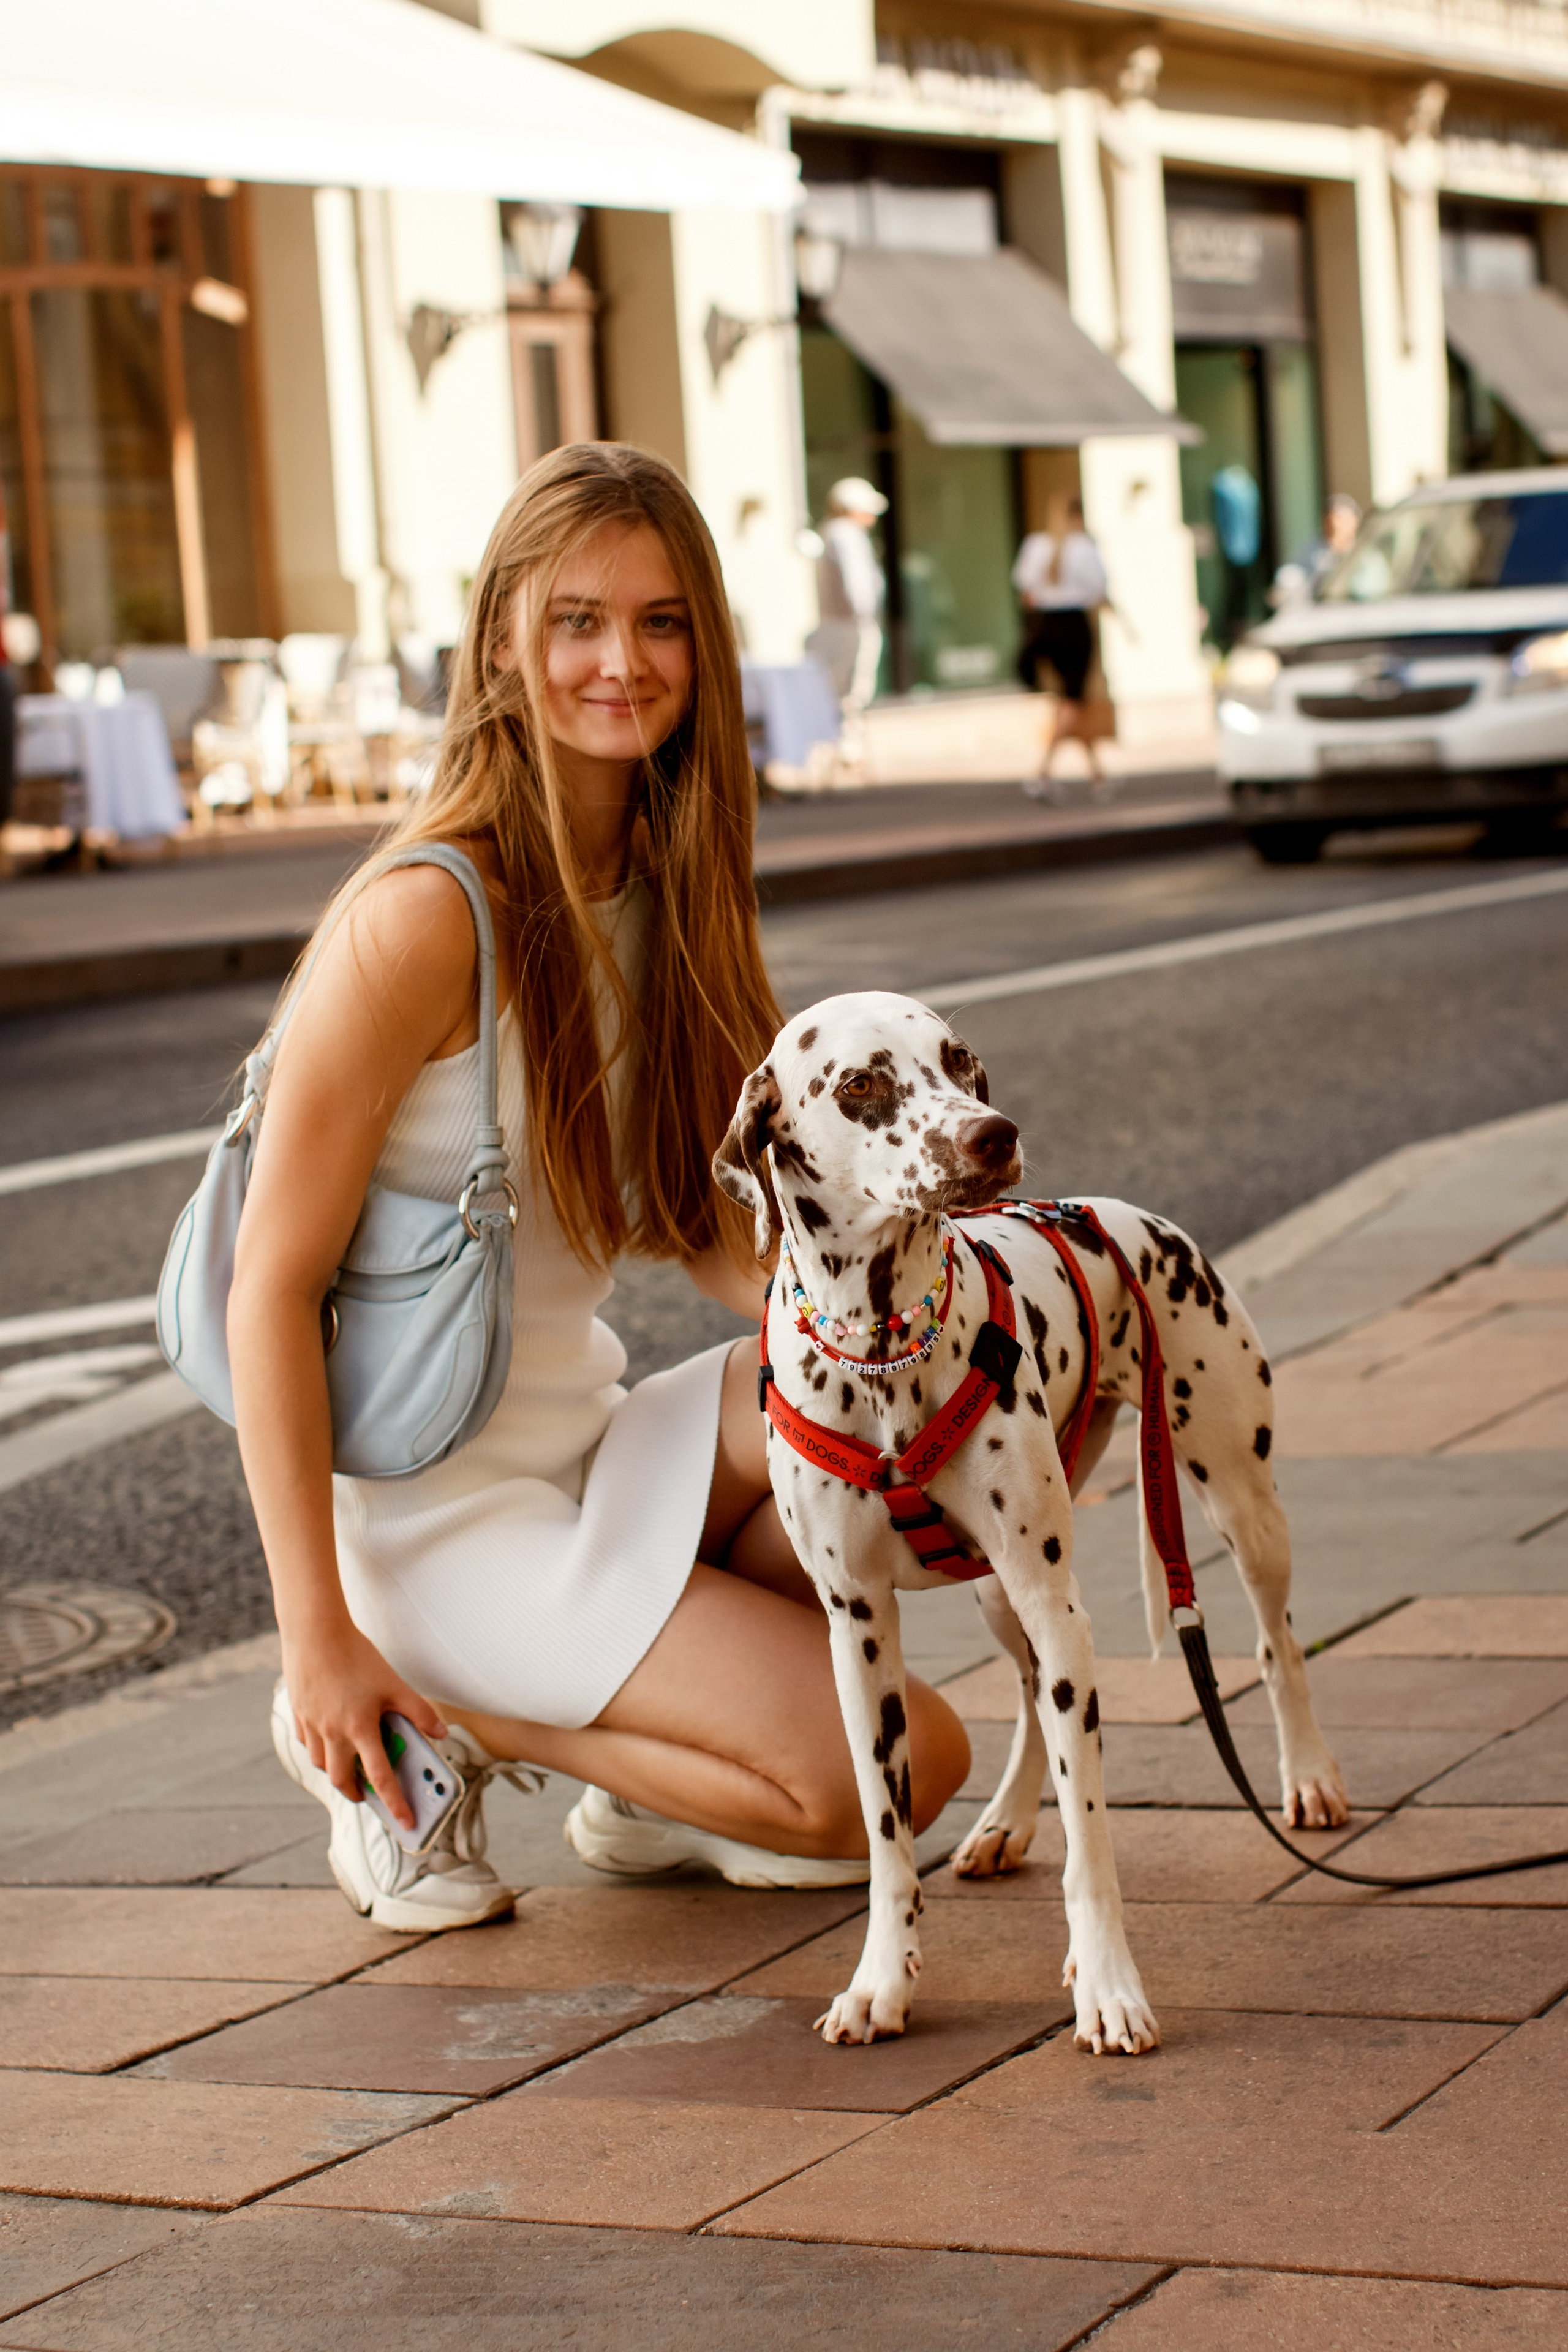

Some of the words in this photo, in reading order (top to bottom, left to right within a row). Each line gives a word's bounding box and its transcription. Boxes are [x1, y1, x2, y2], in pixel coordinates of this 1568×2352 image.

[840, 1335, 940, 1374] 79278979895
[772, 1404, 790, 1433] FOR
[805, 1439, 851, 1472] DOGS.
[1147, 1449, 1162, 1479] FOR
[1148, 1482, 1170, 1553] DESIGNED
